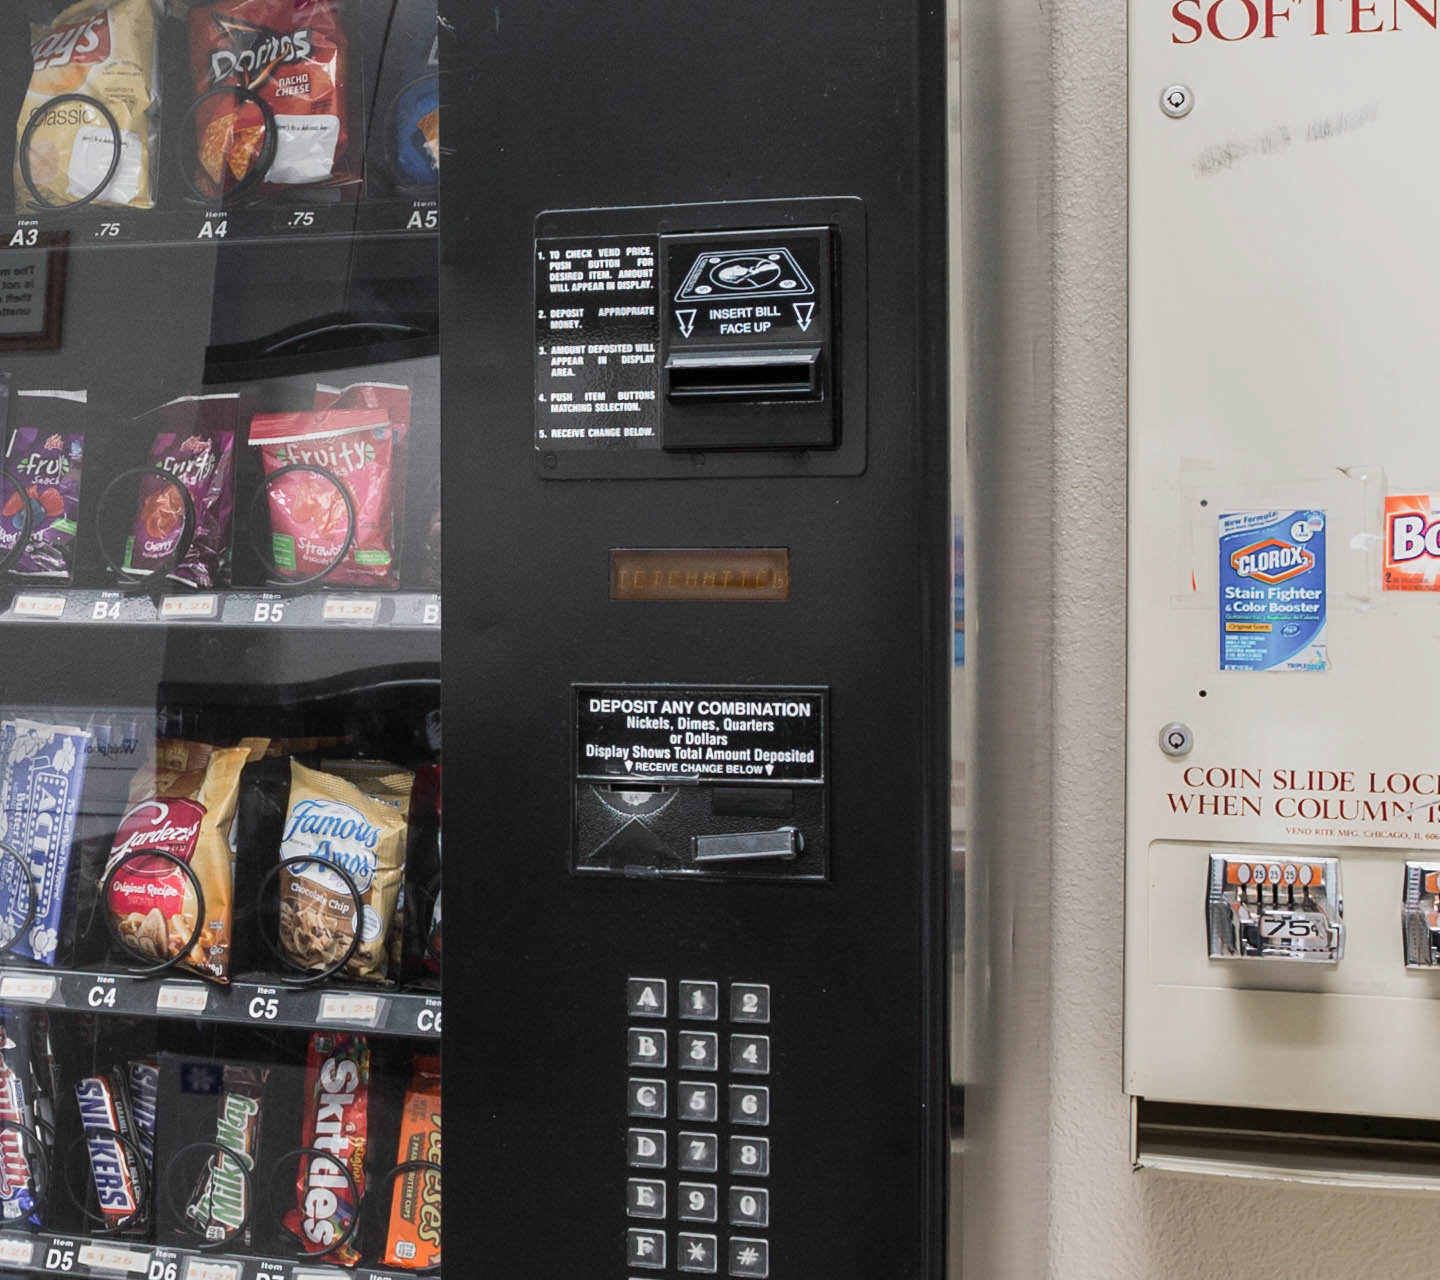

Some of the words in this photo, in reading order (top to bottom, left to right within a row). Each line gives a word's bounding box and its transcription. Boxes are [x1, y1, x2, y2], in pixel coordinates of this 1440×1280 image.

[212, 29, 313, 83] Doritos
[278, 73, 309, 88] NACHO
[276, 82, 311, 98] CHEESE
[198, 221, 228, 238] A4
[287, 212, 314, 226] .75
[9, 228, 38, 246] A3
[550, 308, 584, 318] DEPOSIT
[598, 306, 654, 317] APPROPRIATE
[710, 307, 753, 319] INSERT
[756, 306, 781, 317] BILL
[721, 323, 751, 334] FACE
[754, 322, 771, 332] UP
[551, 345, 586, 355] AMOUNT
[588, 344, 633, 354] DEPOSITED
[635, 343, 655, 353] WILL
[551, 392, 572, 402] PUSH
[585, 392, 605, 401] ITEM
[618, 391, 655, 401] BUTTONS
[551, 404, 592, 413] MATCHING
[551, 429, 585, 439] RECEIVE
[588, 429, 620, 438] CHANGE
[1238, 546, 1303, 575] CLOROX
[1225, 587, 1264, 599] Stain
[1268, 587, 1322, 601] Fighter
[254, 603, 283, 622] B5
[1233, 602, 1265, 612] Color
[1269, 603, 1319, 612] Booster
[590, 699, 658, 714] DEPOSIT
[662, 701, 694, 715] ANY
[698, 701, 811, 717] COMBINATION
[627, 717, 673, 732] Nickels,
[723, 718, 774, 732] Quarters
[670, 735, 683, 745] or
[685, 732, 728, 746] Dollars
[586, 745, 629, 760] Display
[632, 746, 671, 759] Shows
[674, 747, 702, 760] Total
[705, 748, 750, 761] Amount
[754, 749, 814, 764] Deposited
[635, 762, 678, 772] RECEIVE
[680, 763, 724, 773] CHANGE
[726, 763, 763, 774] BELOW
[1183, 767, 1262, 790] COIN
[1273, 768, 1355, 793] SLIDE
[1168, 793, 1262, 817] WHEN
[1275, 797, 1415, 823] COLUMN
[283, 800, 382, 848] Famous
[303, 840, 374, 877] Amos
[290, 882, 330, 907] Chocolate
[328, 898, 350, 914] Chip
[637, 987, 658, 1006] A
[692, 990, 704, 1009] 1
[743, 993, 759, 1013] 2
[638, 1036, 656, 1056] B
[690, 1040, 706, 1059] 3
[742, 1044, 758, 1063] 4
[636, 1087, 656, 1107] C
[690, 1091, 706, 1110] 5
[741, 1095, 757, 1114] 6
[305, 1057, 359, 1248] Skittles
[636, 1136, 656, 1156] D
[690, 1141, 706, 1160] 7
[741, 1145, 757, 1164] 8
